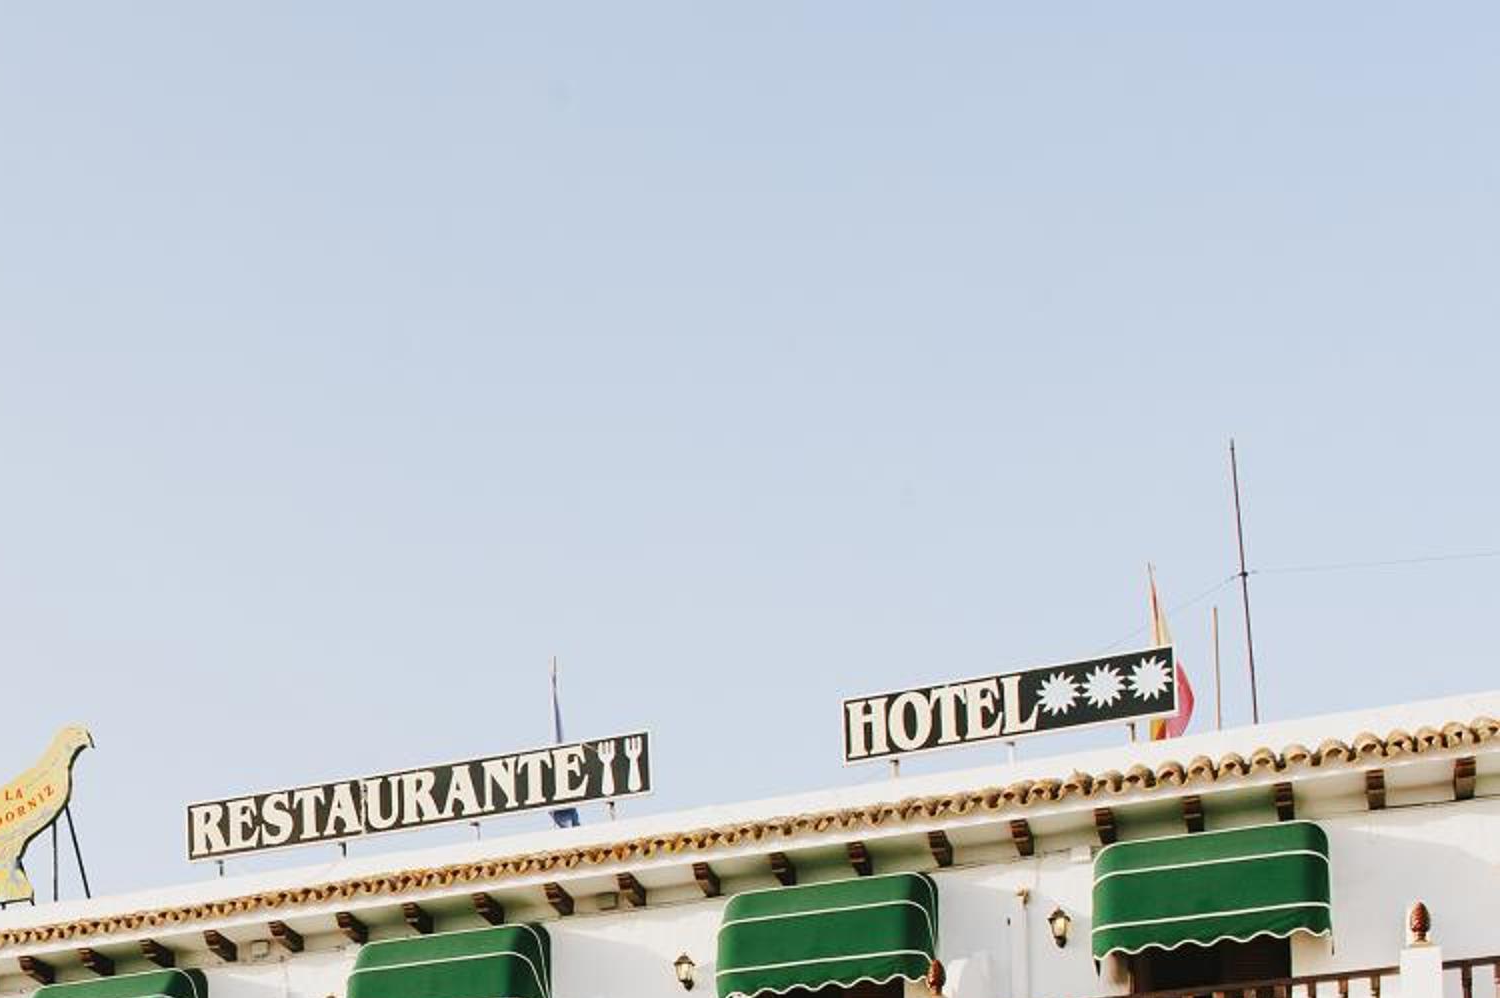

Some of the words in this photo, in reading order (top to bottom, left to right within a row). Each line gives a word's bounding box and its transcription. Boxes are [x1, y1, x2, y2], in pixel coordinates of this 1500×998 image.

[845, 674, 1040, 758] HOTEL
[4, 787, 24, 801] LA
[190, 743, 589, 857] RESTAURANTE
